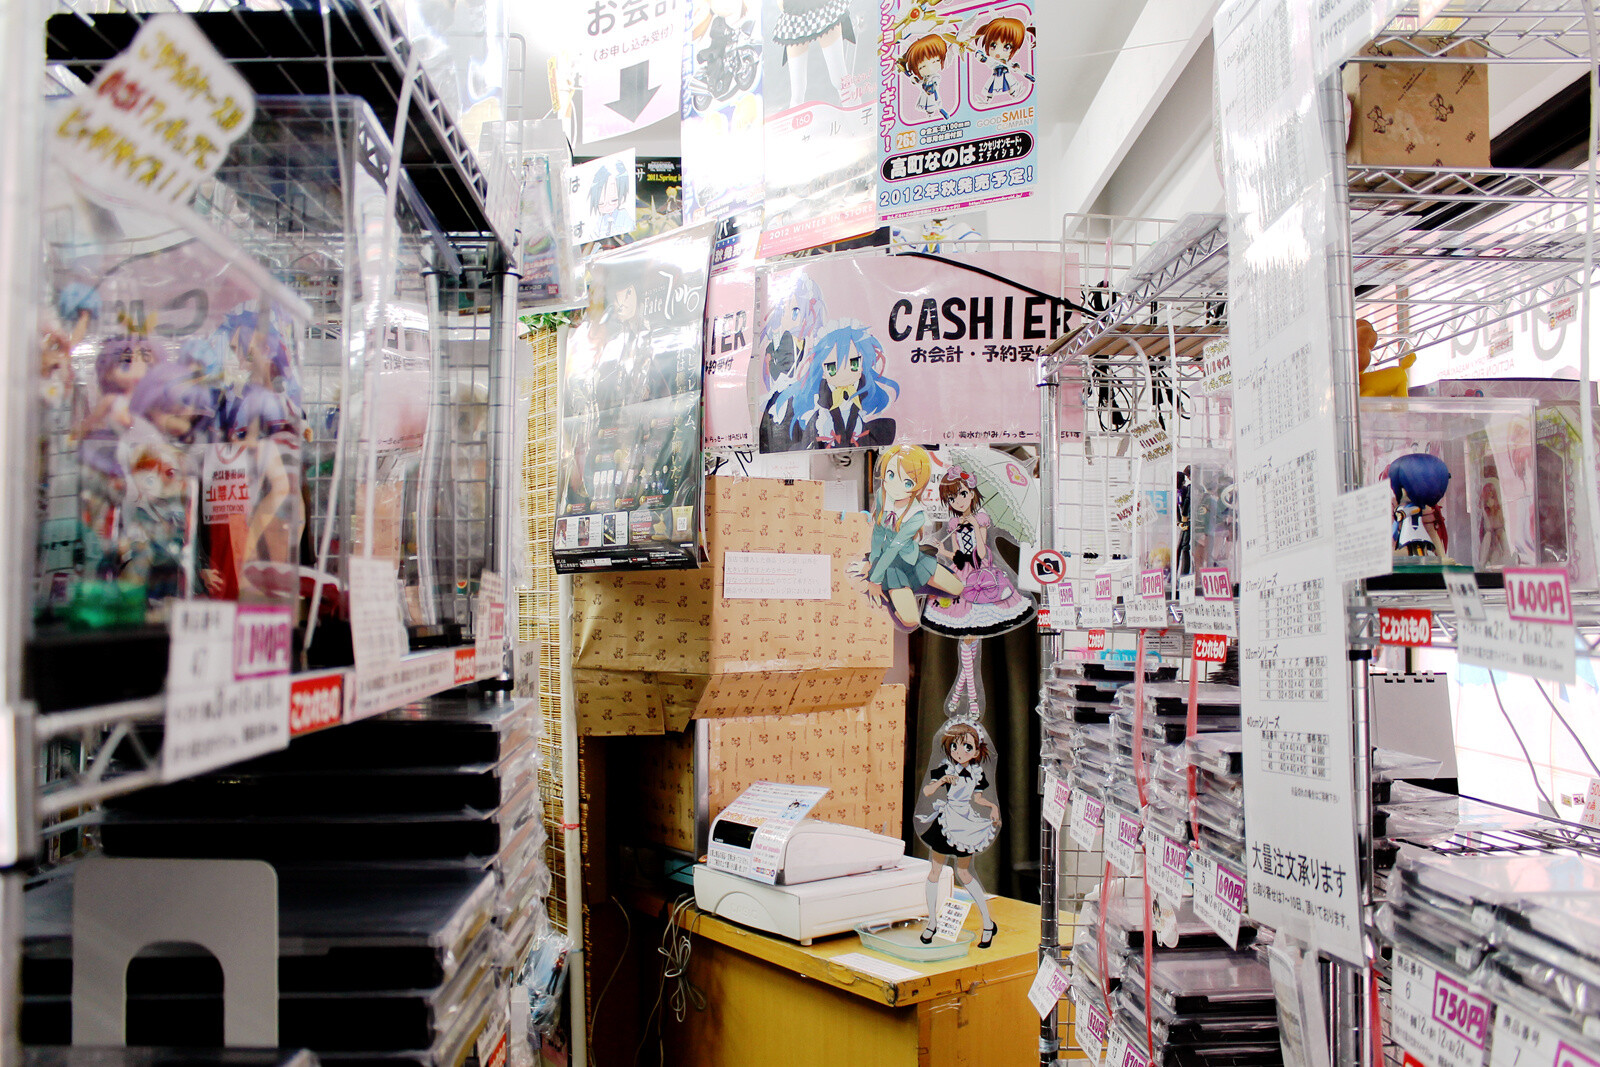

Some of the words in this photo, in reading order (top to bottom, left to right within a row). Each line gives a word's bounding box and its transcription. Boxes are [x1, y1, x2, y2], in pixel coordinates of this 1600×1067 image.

[593, 24, 674, 62] (お申し込み受付)
[976, 117, 1002, 128] GOOD
[1002, 107, 1034, 123] SMILE
[996, 119, 1034, 131] COMPANY
[896, 131, 917, 149] 263
[890, 144, 976, 179] 高町なのは
[880, 166, 1034, 206] 2012年秋発売予定!
[793, 217, 828, 233] WINTER
[844, 203, 874, 218] STORE
[643, 296, 663, 316] Fate
[888, 296, 1073, 343] CASHIER
[1202, 574, 1229, 595] 910円
[1507, 580, 1566, 616] 1400円
[1381, 616, 1430, 644] こわれもの
[1195, 639, 1225, 659] こわれもの
[1246, 715, 1280, 730] 40cmシリーズ
[1165, 845, 1185, 873] 630円
[1252, 841, 1346, 898] 大量注文承ります
[1218, 874, 1243, 908] 690円
[1405, 981, 1411, 1000] 6
[1439, 987, 1485, 1040] 750円
